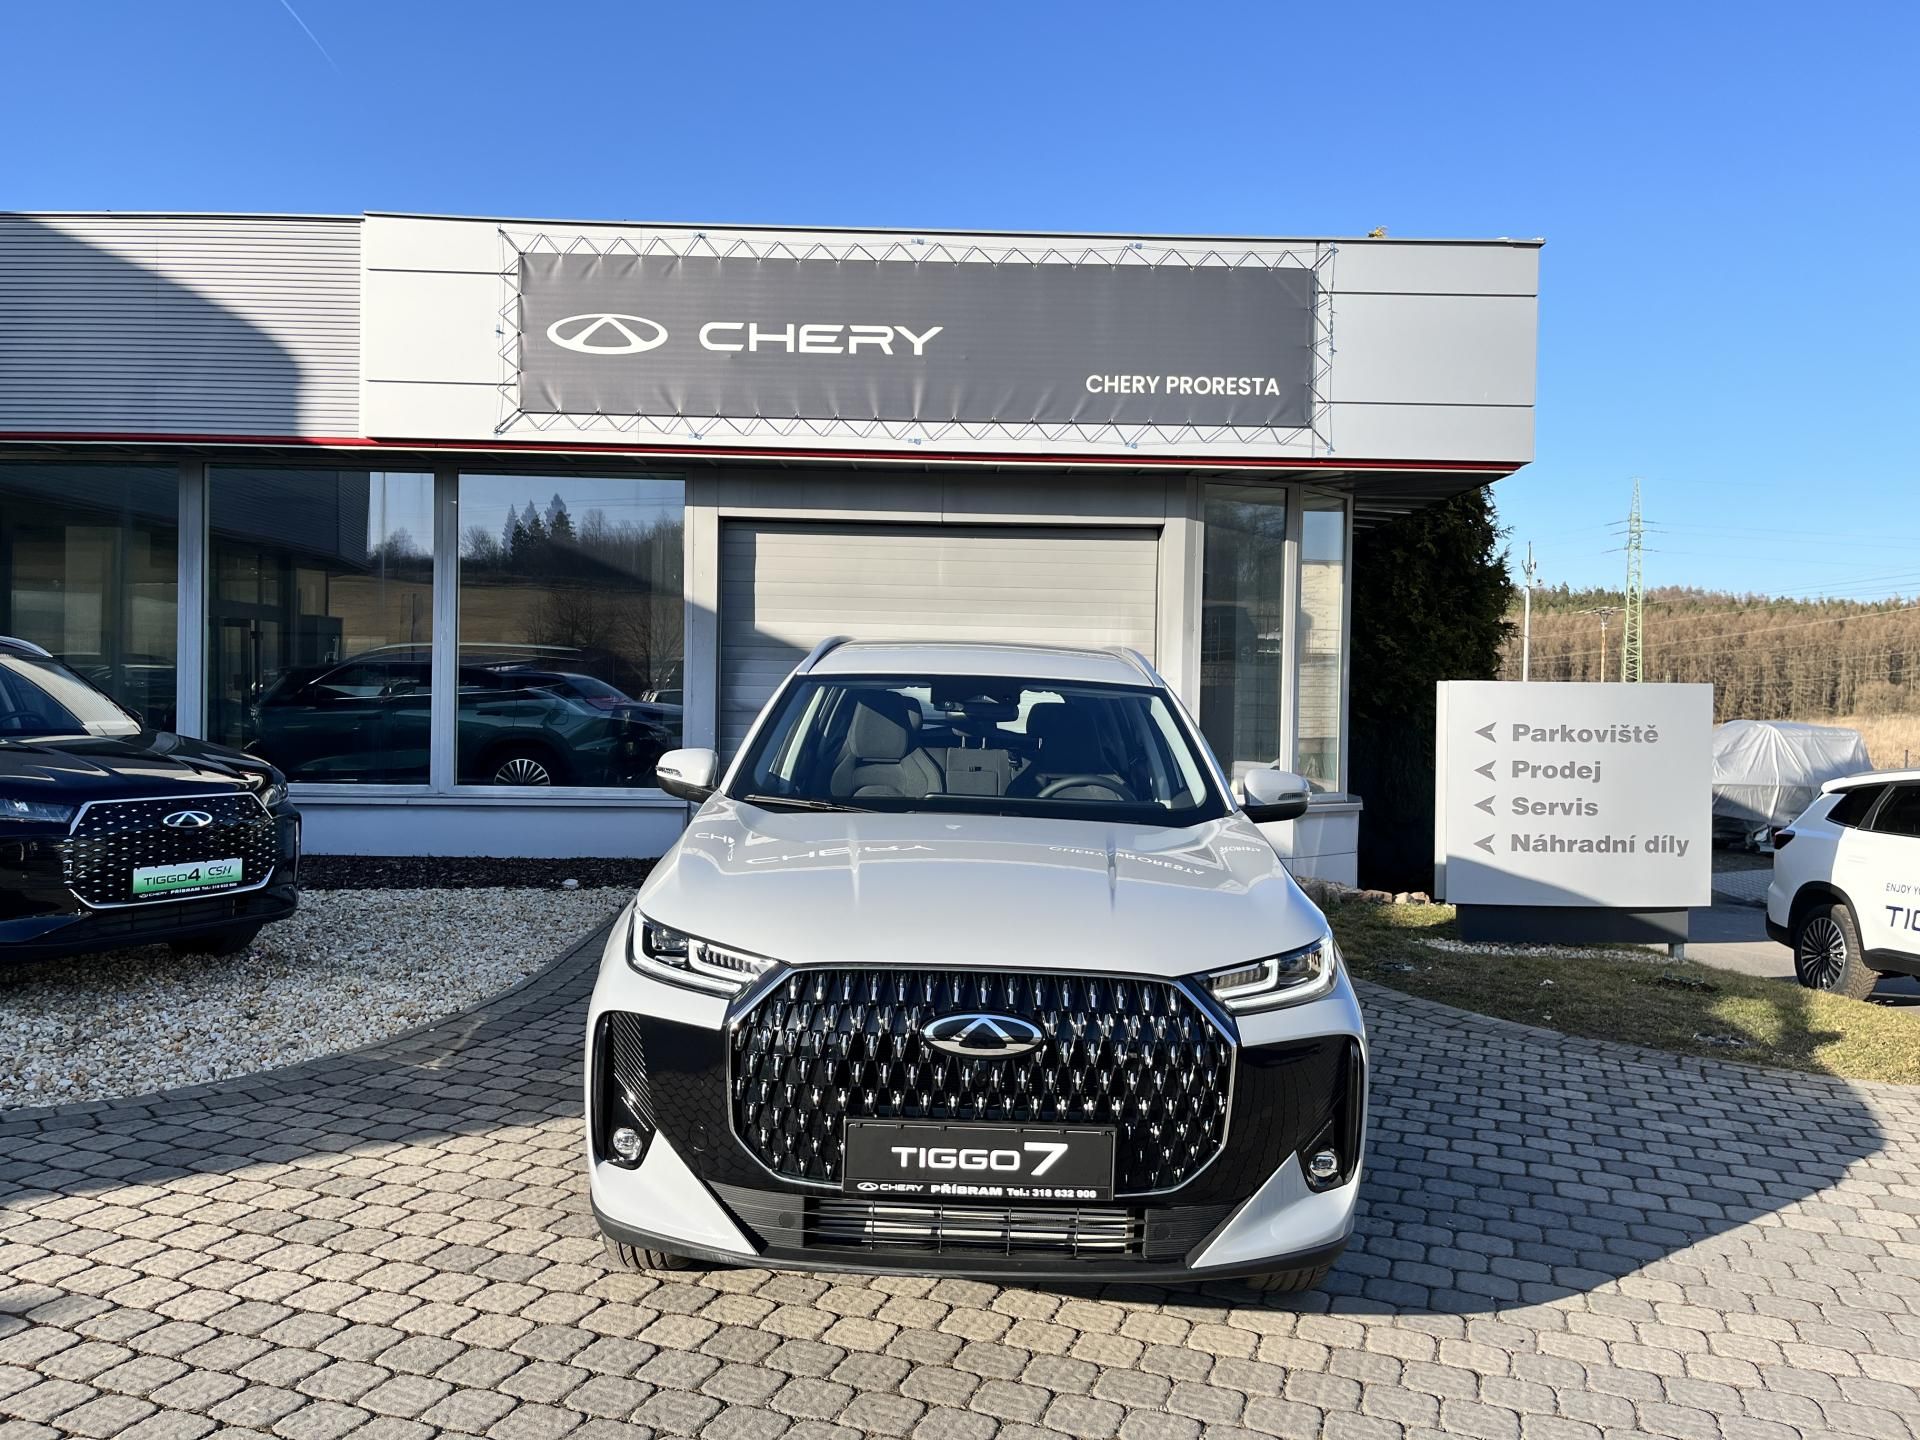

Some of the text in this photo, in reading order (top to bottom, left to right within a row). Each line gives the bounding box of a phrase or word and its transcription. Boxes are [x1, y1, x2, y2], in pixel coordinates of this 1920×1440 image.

[699, 321, 944, 356] CHERY
[1086, 374, 1280, 396] CHERY PRORESTA
[1511, 723, 1659, 744] Parkoviště
[1511, 760, 1601, 783] Prodej
[1511, 797, 1599, 817] Servis
[1510, 833, 1690, 857] Náhradní díly
[1885, 882, 1911, 894] ENJOY
[879, 1183, 924, 1193] CHERY
[930, 1183, 1003, 1196] PŘÍBRAM
[1007, 1187, 1030, 1197] Tel.:
[1032, 1188, 1052, 1197] 318
[1054, 1189, 1075, 1198] 632
